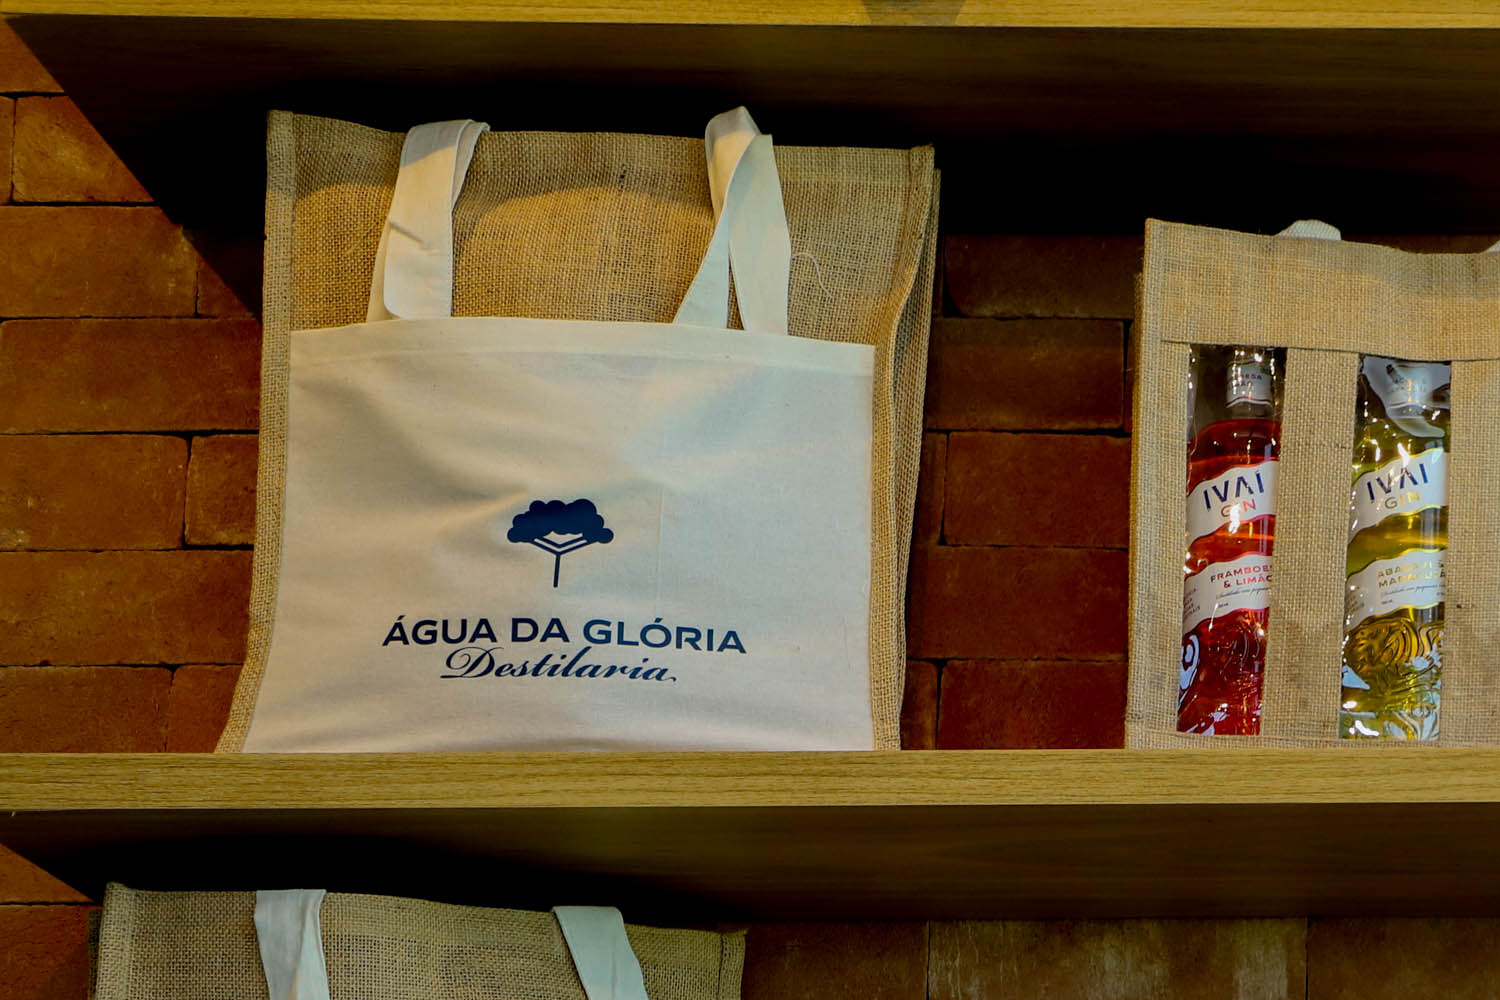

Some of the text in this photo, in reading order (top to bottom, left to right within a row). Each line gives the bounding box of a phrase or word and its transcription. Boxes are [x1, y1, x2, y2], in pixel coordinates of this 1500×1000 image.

[382, 615, 747, 654] ÁGUA DA GLÓRIA
[440, 646, 676, 682] Destilaria
